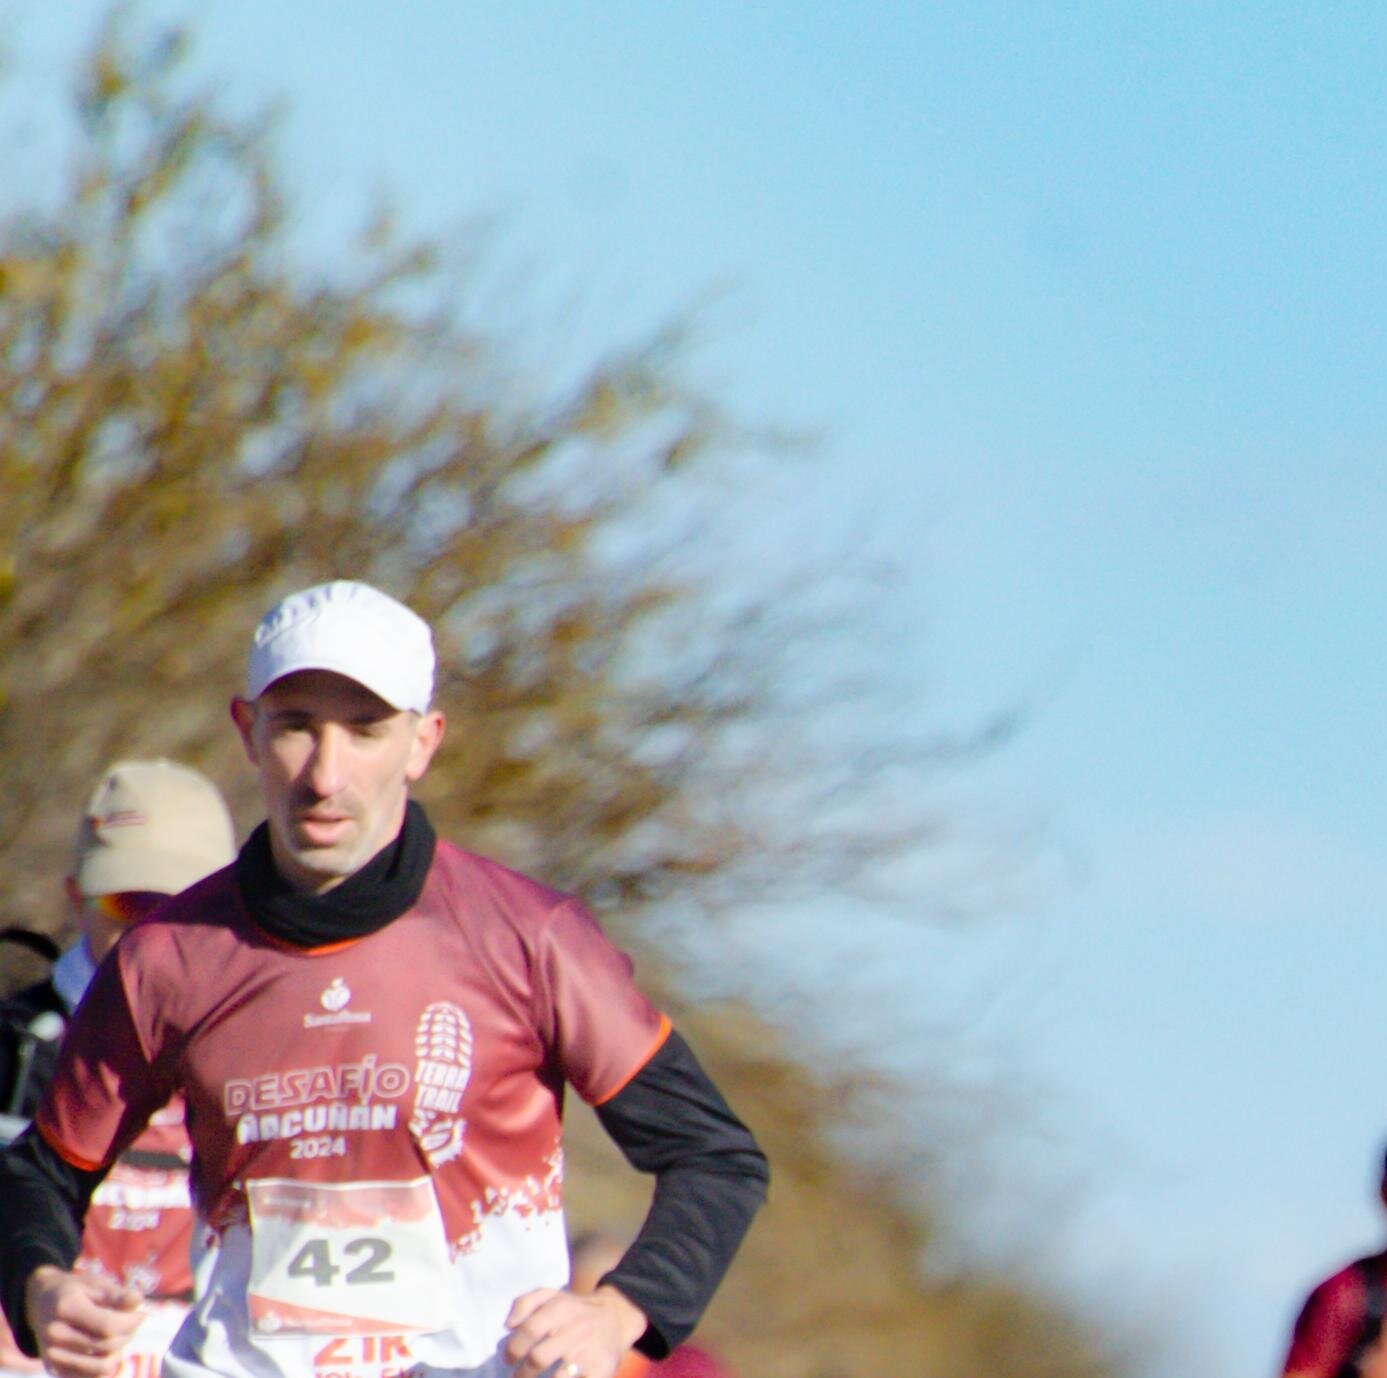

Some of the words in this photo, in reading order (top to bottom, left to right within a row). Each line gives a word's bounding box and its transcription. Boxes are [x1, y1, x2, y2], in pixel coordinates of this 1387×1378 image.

[224, 1054, 410, 1116] DESAFÍO
[415, 1058, 473, 1092] TERRA
[415, 1085, 463, 1114] TRAIL
[289, 1135, 347, 1160] 2024
[287, 1237, 396, 1287] 42
